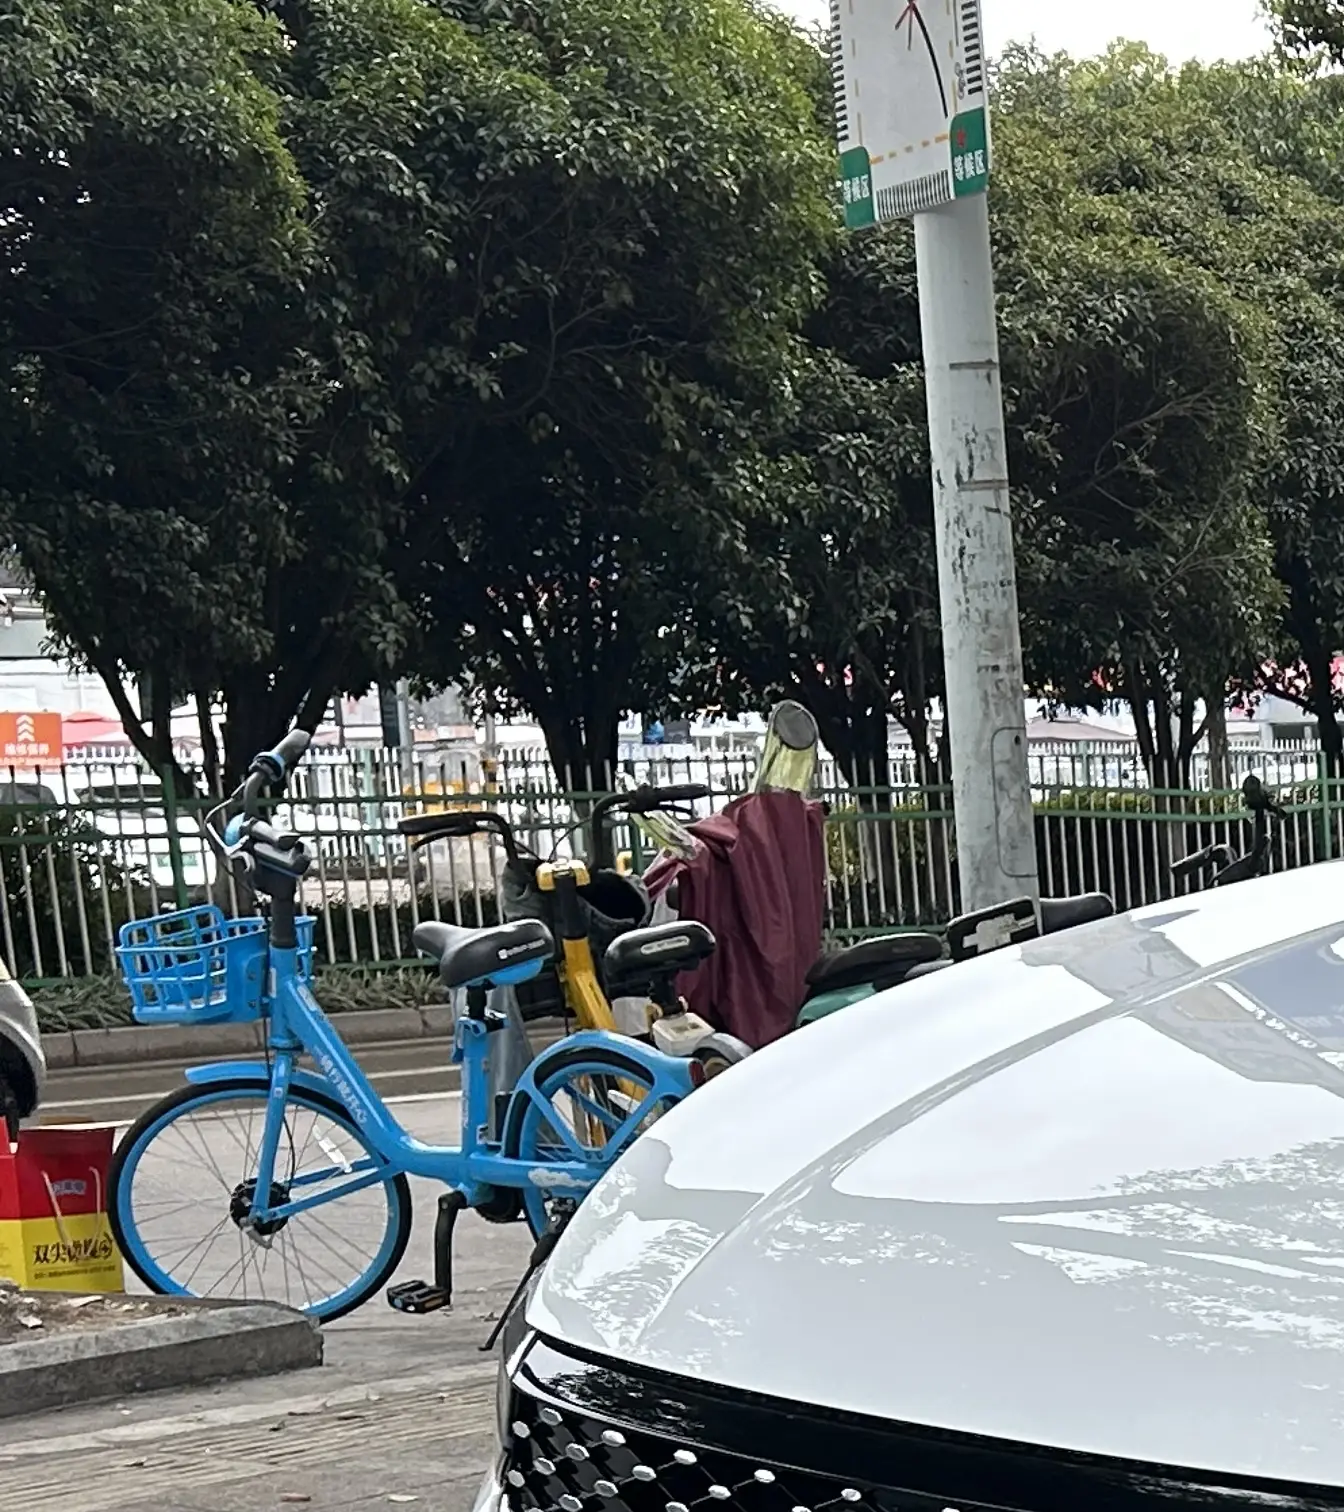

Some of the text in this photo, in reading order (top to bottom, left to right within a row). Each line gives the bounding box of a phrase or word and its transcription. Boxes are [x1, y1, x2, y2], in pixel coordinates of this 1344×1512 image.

[954, 149, 985, 181] 等候区
[842, 174, 871, 204] 等候区
